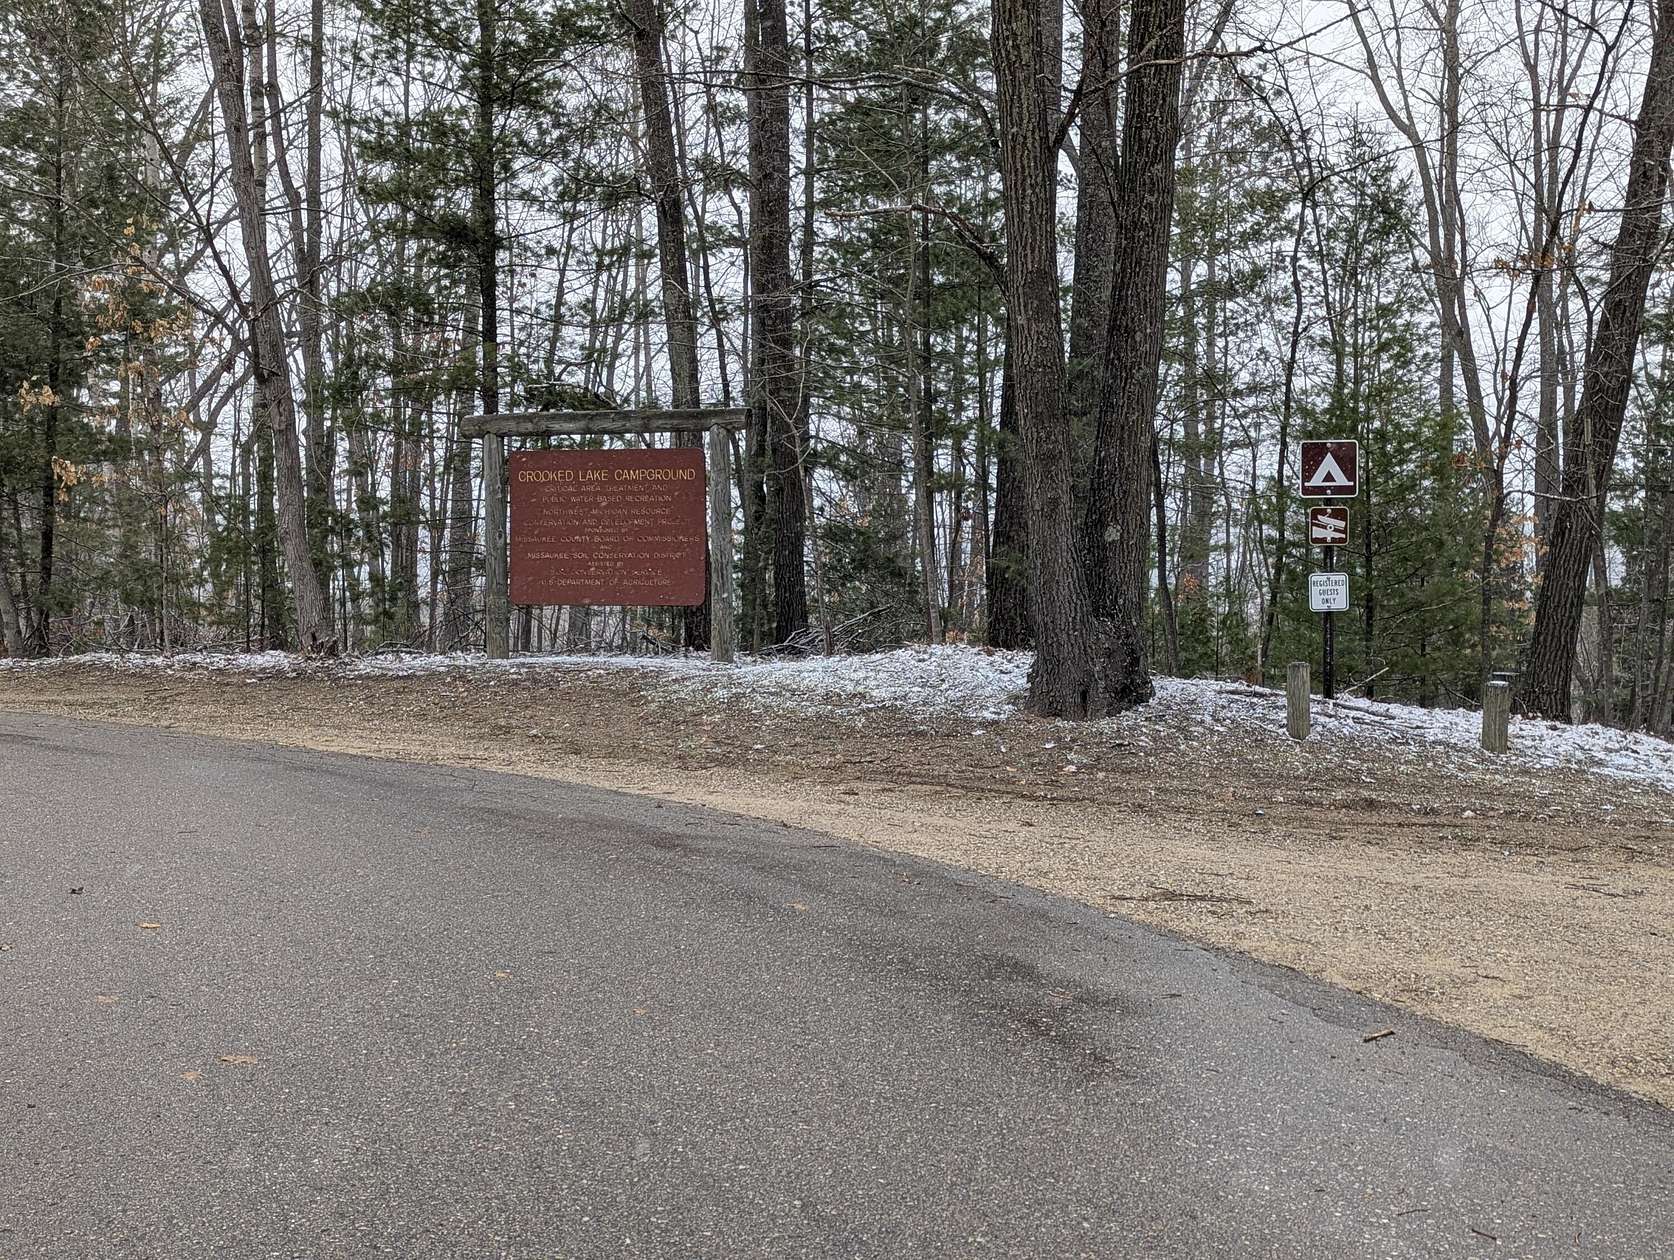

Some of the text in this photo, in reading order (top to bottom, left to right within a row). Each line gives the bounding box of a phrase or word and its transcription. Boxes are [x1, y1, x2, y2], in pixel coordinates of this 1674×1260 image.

[518, 469, 696, 482] CROOKED LAKE CAMPGROUND
[560, 535, 590, 543] COUNTY
[1312, 579, 1344, 587] REGISTERED
[1318, 588, 1339, 596] GUESTS
[1321, 597, 1336, 605] ONLY
